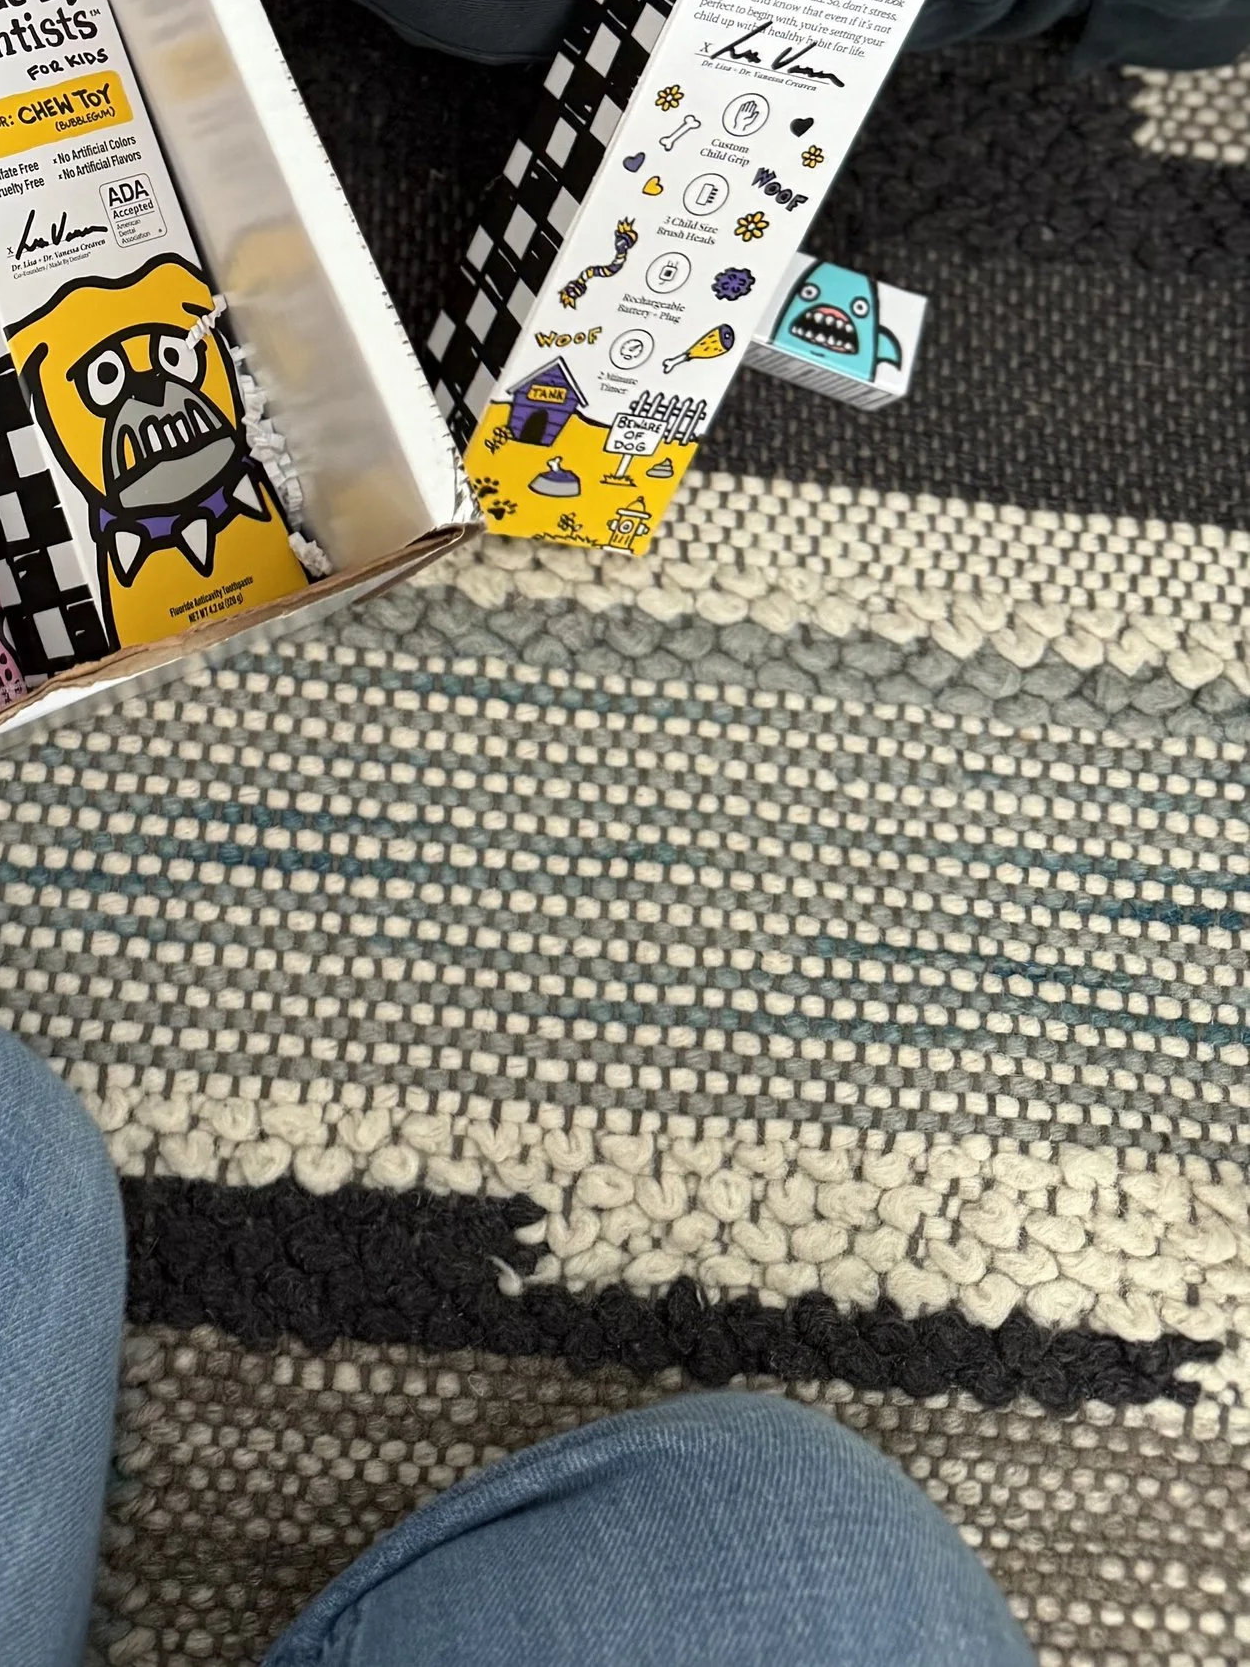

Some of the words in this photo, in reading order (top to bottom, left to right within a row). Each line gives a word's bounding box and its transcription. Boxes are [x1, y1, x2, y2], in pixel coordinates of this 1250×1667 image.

[26, 59, 64, 81] FOR
[63, 47, 108, 68] KIDS
[17, 93, 74, 124] CHEW
[70, 82, 110, 109] TOY
[54, 105, 115, 132] (BUBBLEGUM)
[56, 152, 71, 164] No
[71, 140, 108, 160] Artificial
[108, 136, 136, 150] Colors
[17, 161, 39, 174] Free
[61, 167, 75, 179] No
[75, 156, 111, 176] Artificial
[110, 150, 141, 166] Flavors
[23, 177, 45, 190] Free
[108, 179, 149, 207] ADA
[111, 198, 154, 219] Accepted
[535, 326, 603, 348] WOOF
[533, 388, 563, 400] TANK
[617, 416, 662, 434] BEWARE
[624, 431, 645, 440] OF
[613, 440, 646, 452] DOG
